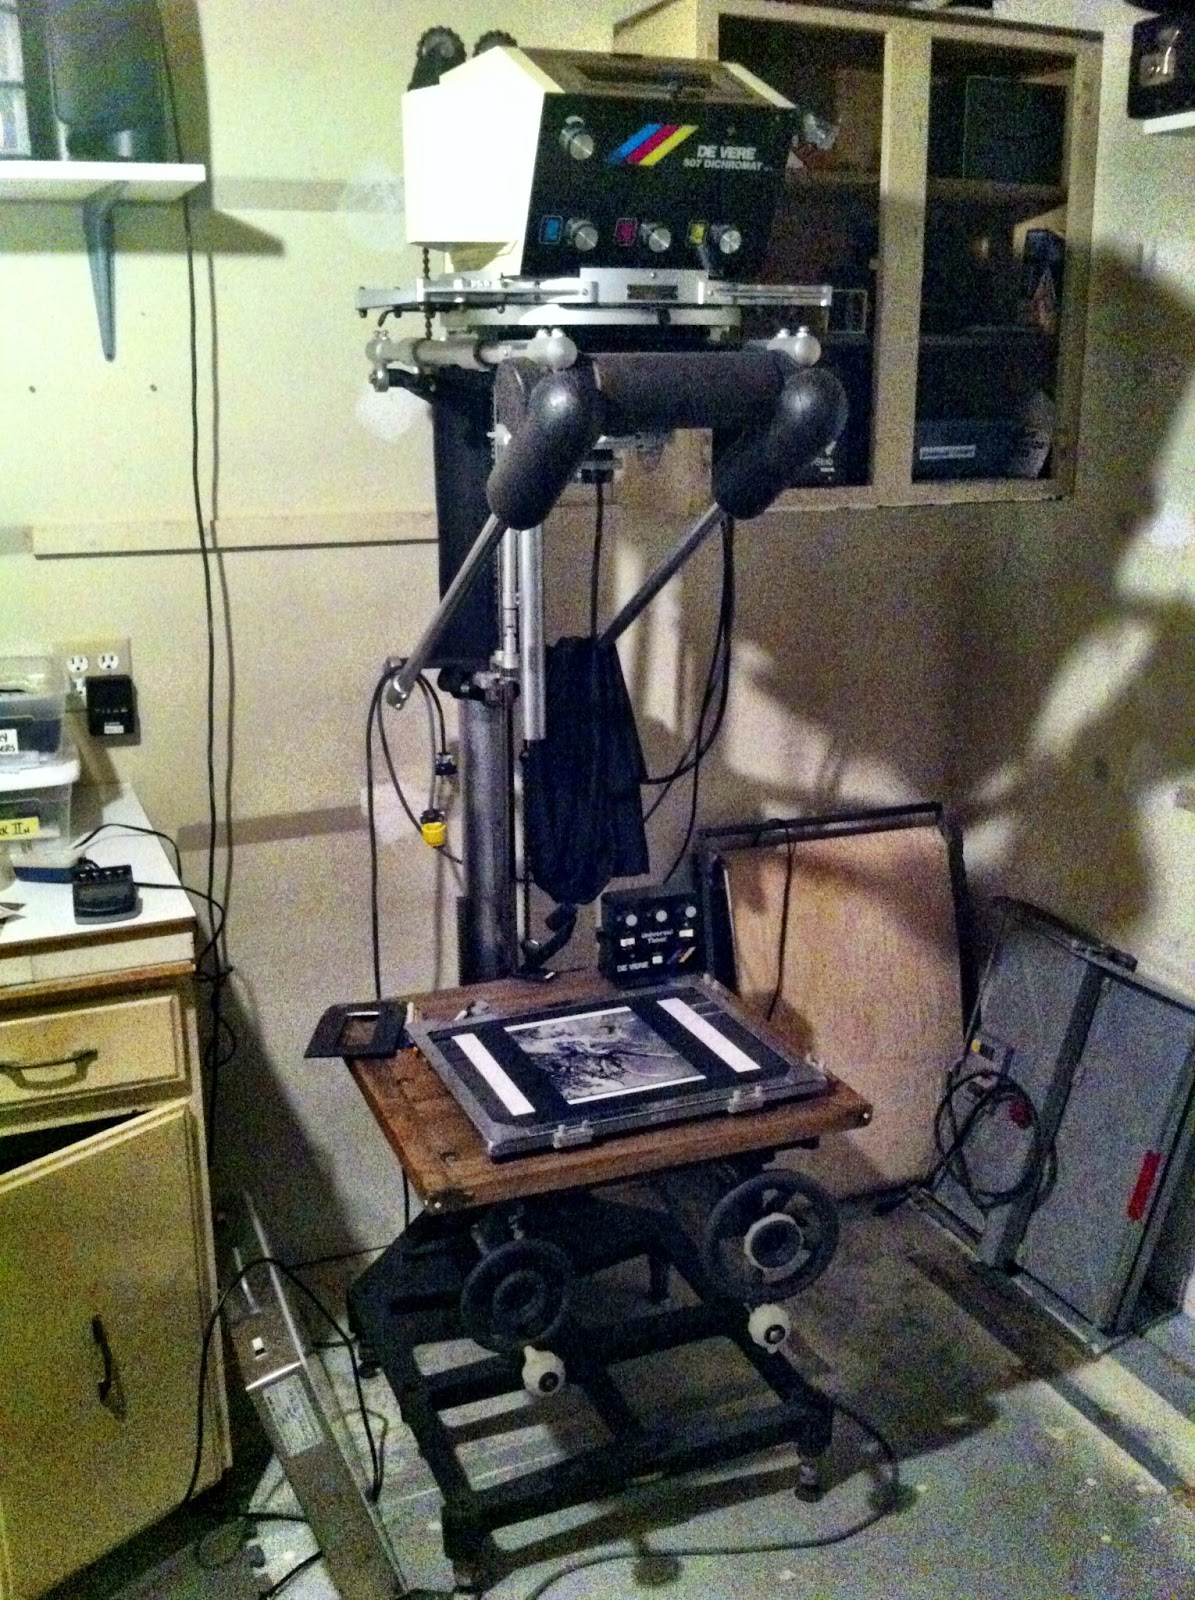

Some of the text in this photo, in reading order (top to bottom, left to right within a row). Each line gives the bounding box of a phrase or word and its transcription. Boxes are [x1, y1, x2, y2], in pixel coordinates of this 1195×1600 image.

[697, 144, 757, 160] DE VERE
[703, 159, 763, 171] DICHROMAT
[641, 928, 674, 939] Universal
[616, 960, 649, 972] DE VERE
